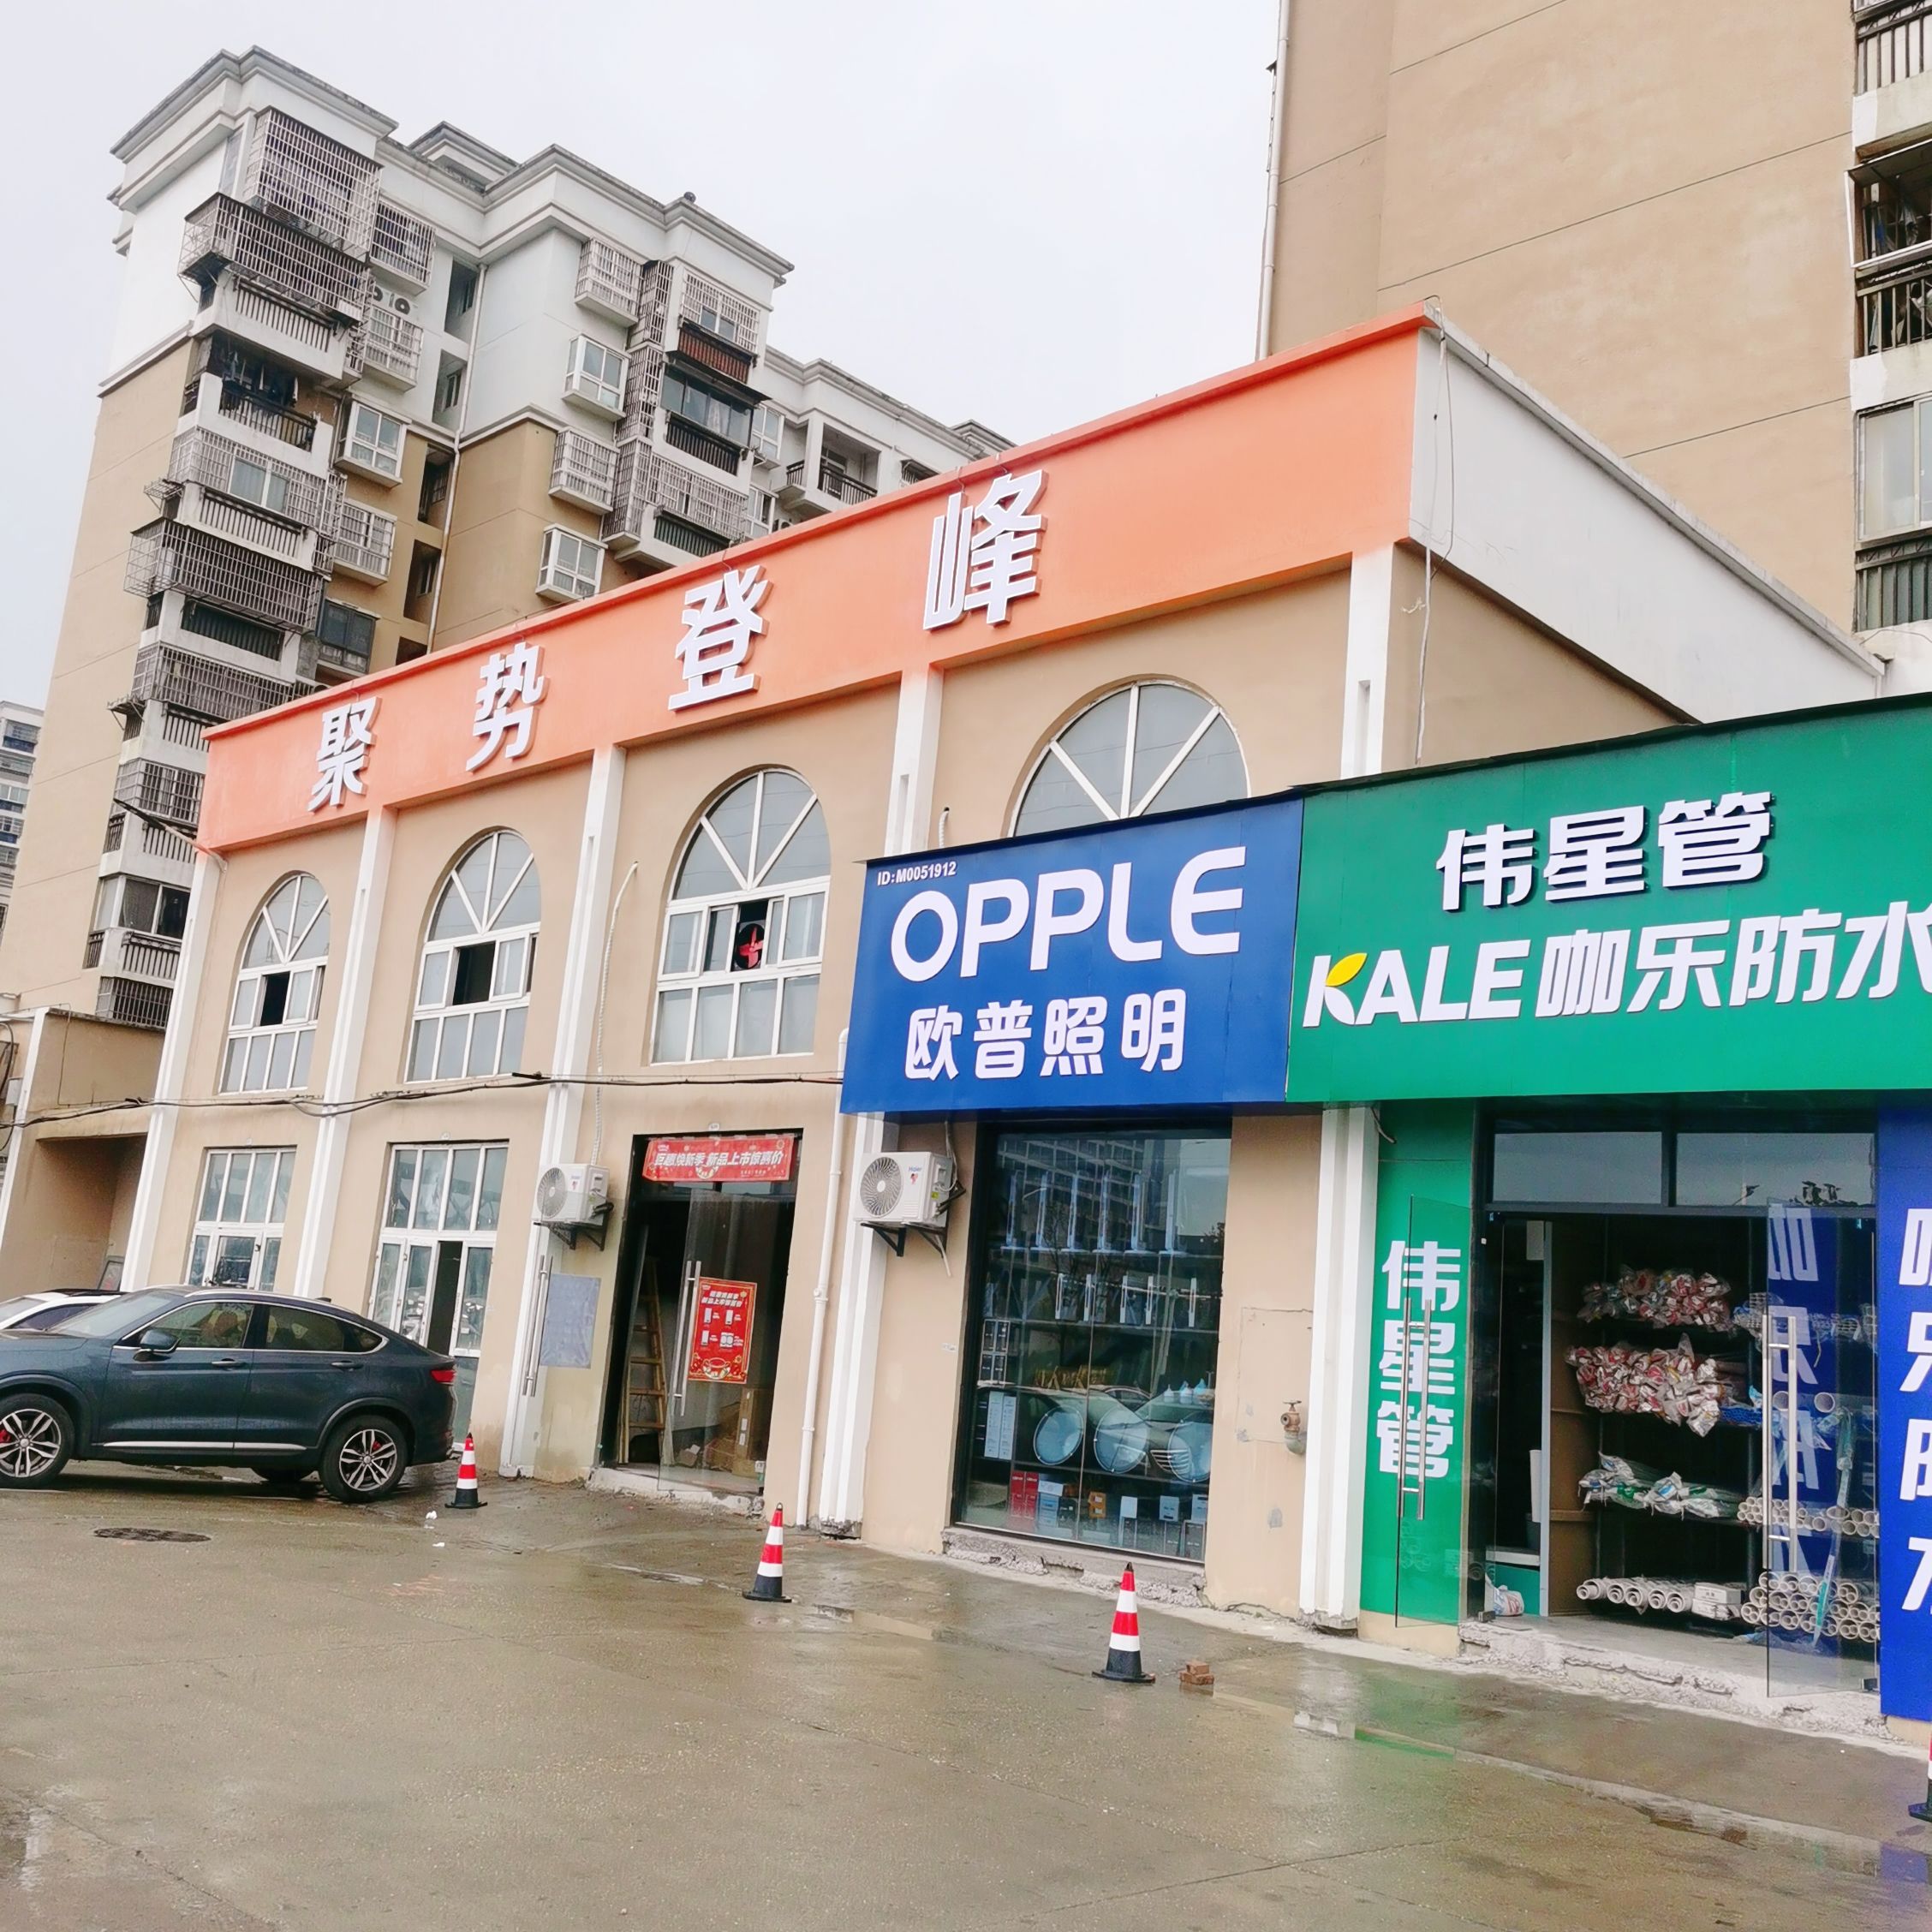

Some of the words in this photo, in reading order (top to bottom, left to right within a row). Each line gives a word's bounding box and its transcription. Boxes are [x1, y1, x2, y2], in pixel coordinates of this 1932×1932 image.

[309, 468, 1047, 812] 聚势登峰
[877, 861, 957, 886] ID:M0051912
[891, 846, 1247, 982] OPPLE
[1436, 791, 1773, 911] 伟星管
[1303, 939, 1531, 1028] KALE
[1535, 900, 1932, 1018] 咖乐防水
[904, 988, 1187, 1081] 欧普照明
[1376, 1239, 1461, 1479] 伟星管
